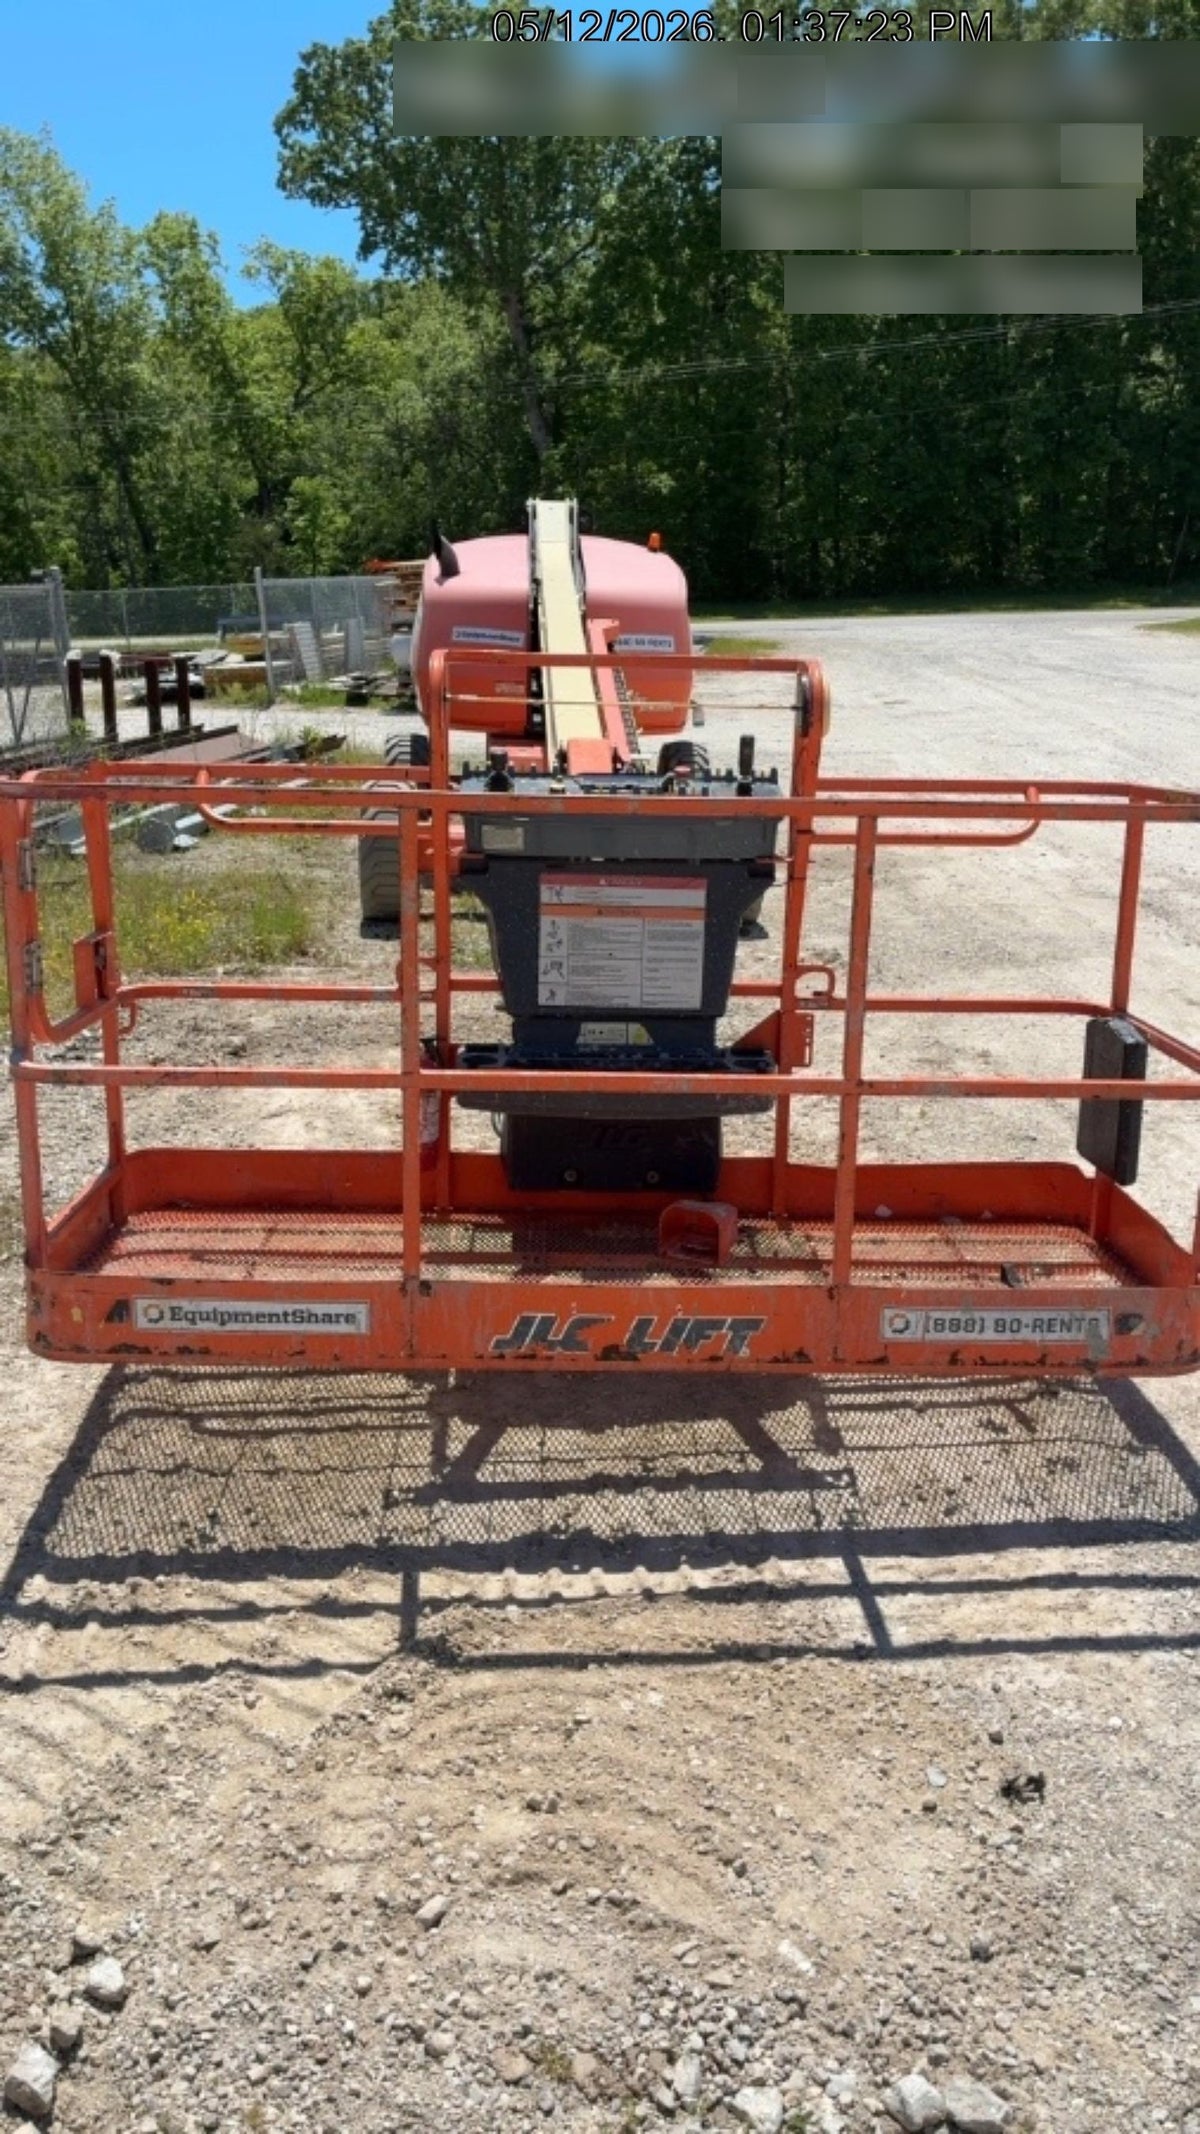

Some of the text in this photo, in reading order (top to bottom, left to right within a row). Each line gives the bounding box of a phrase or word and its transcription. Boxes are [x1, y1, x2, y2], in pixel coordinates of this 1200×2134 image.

[168, 1305, 357, 1327] EquipmentShare
[925, 1317, 986, 1335] (888)
[623, 1314, 768, 1357] LIFT
